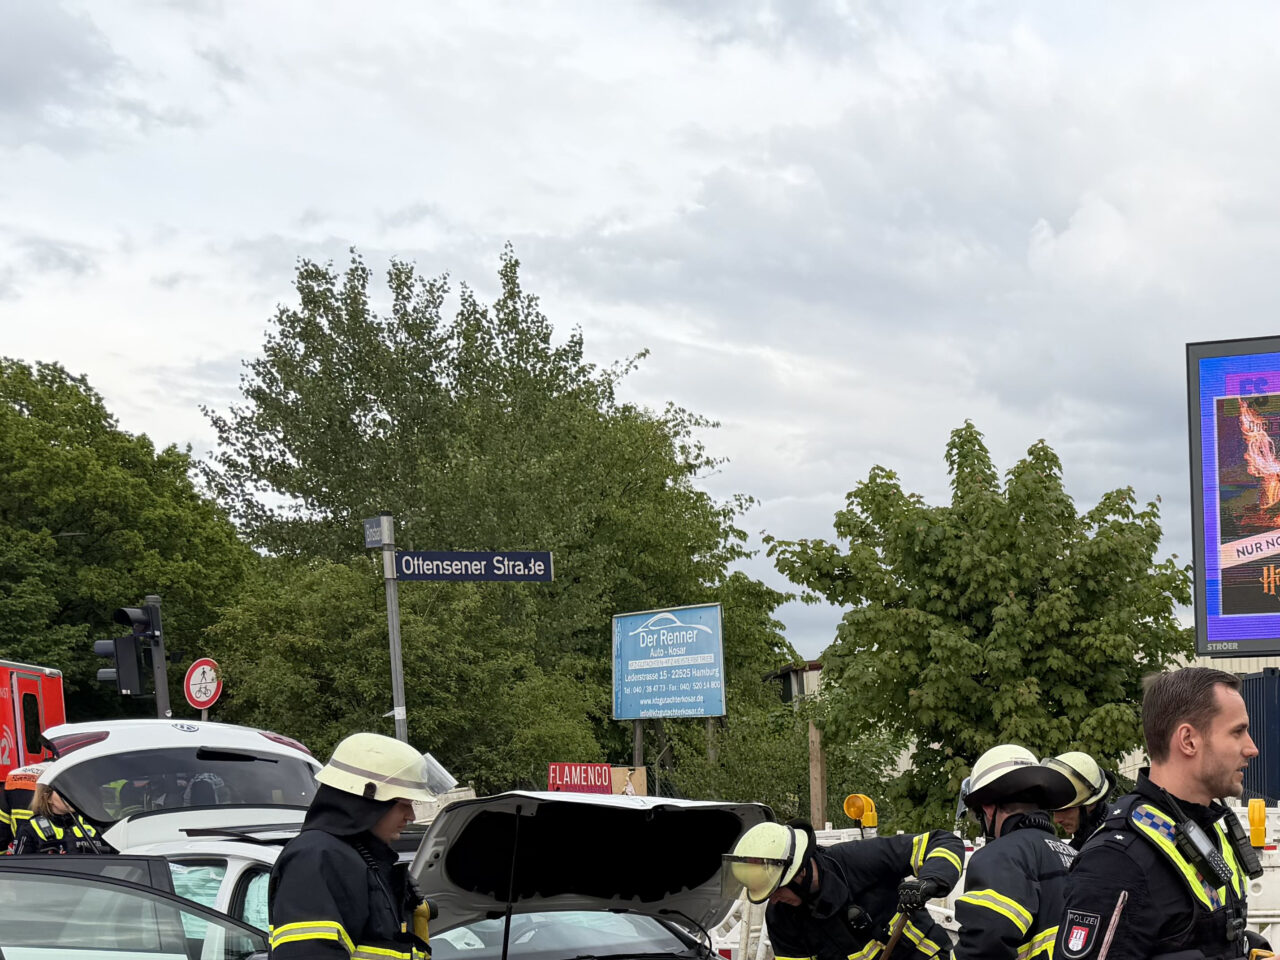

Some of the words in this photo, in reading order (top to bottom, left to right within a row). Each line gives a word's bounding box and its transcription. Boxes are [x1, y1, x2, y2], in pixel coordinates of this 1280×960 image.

[1236, 542, 1263, 558] NUR
[401, 555, 487, 576] Ottensener
[640, 632, 658, 648] Der
[660, 630, 698, 646] Renner
[1207, 642, 1238, 651] STRÖER
[649, 648, 664, 657] Auto
[668, 646, 686, 656] Kosar
[624, 672, 658, 682] Lederstrasse
[659, 671, 667, 680] 15
[692, 667, 720, 678] Hamburg
[549, 765, 609, 786] FLAMENCO
[1069, 913, 1099, 926] POLIZEI
